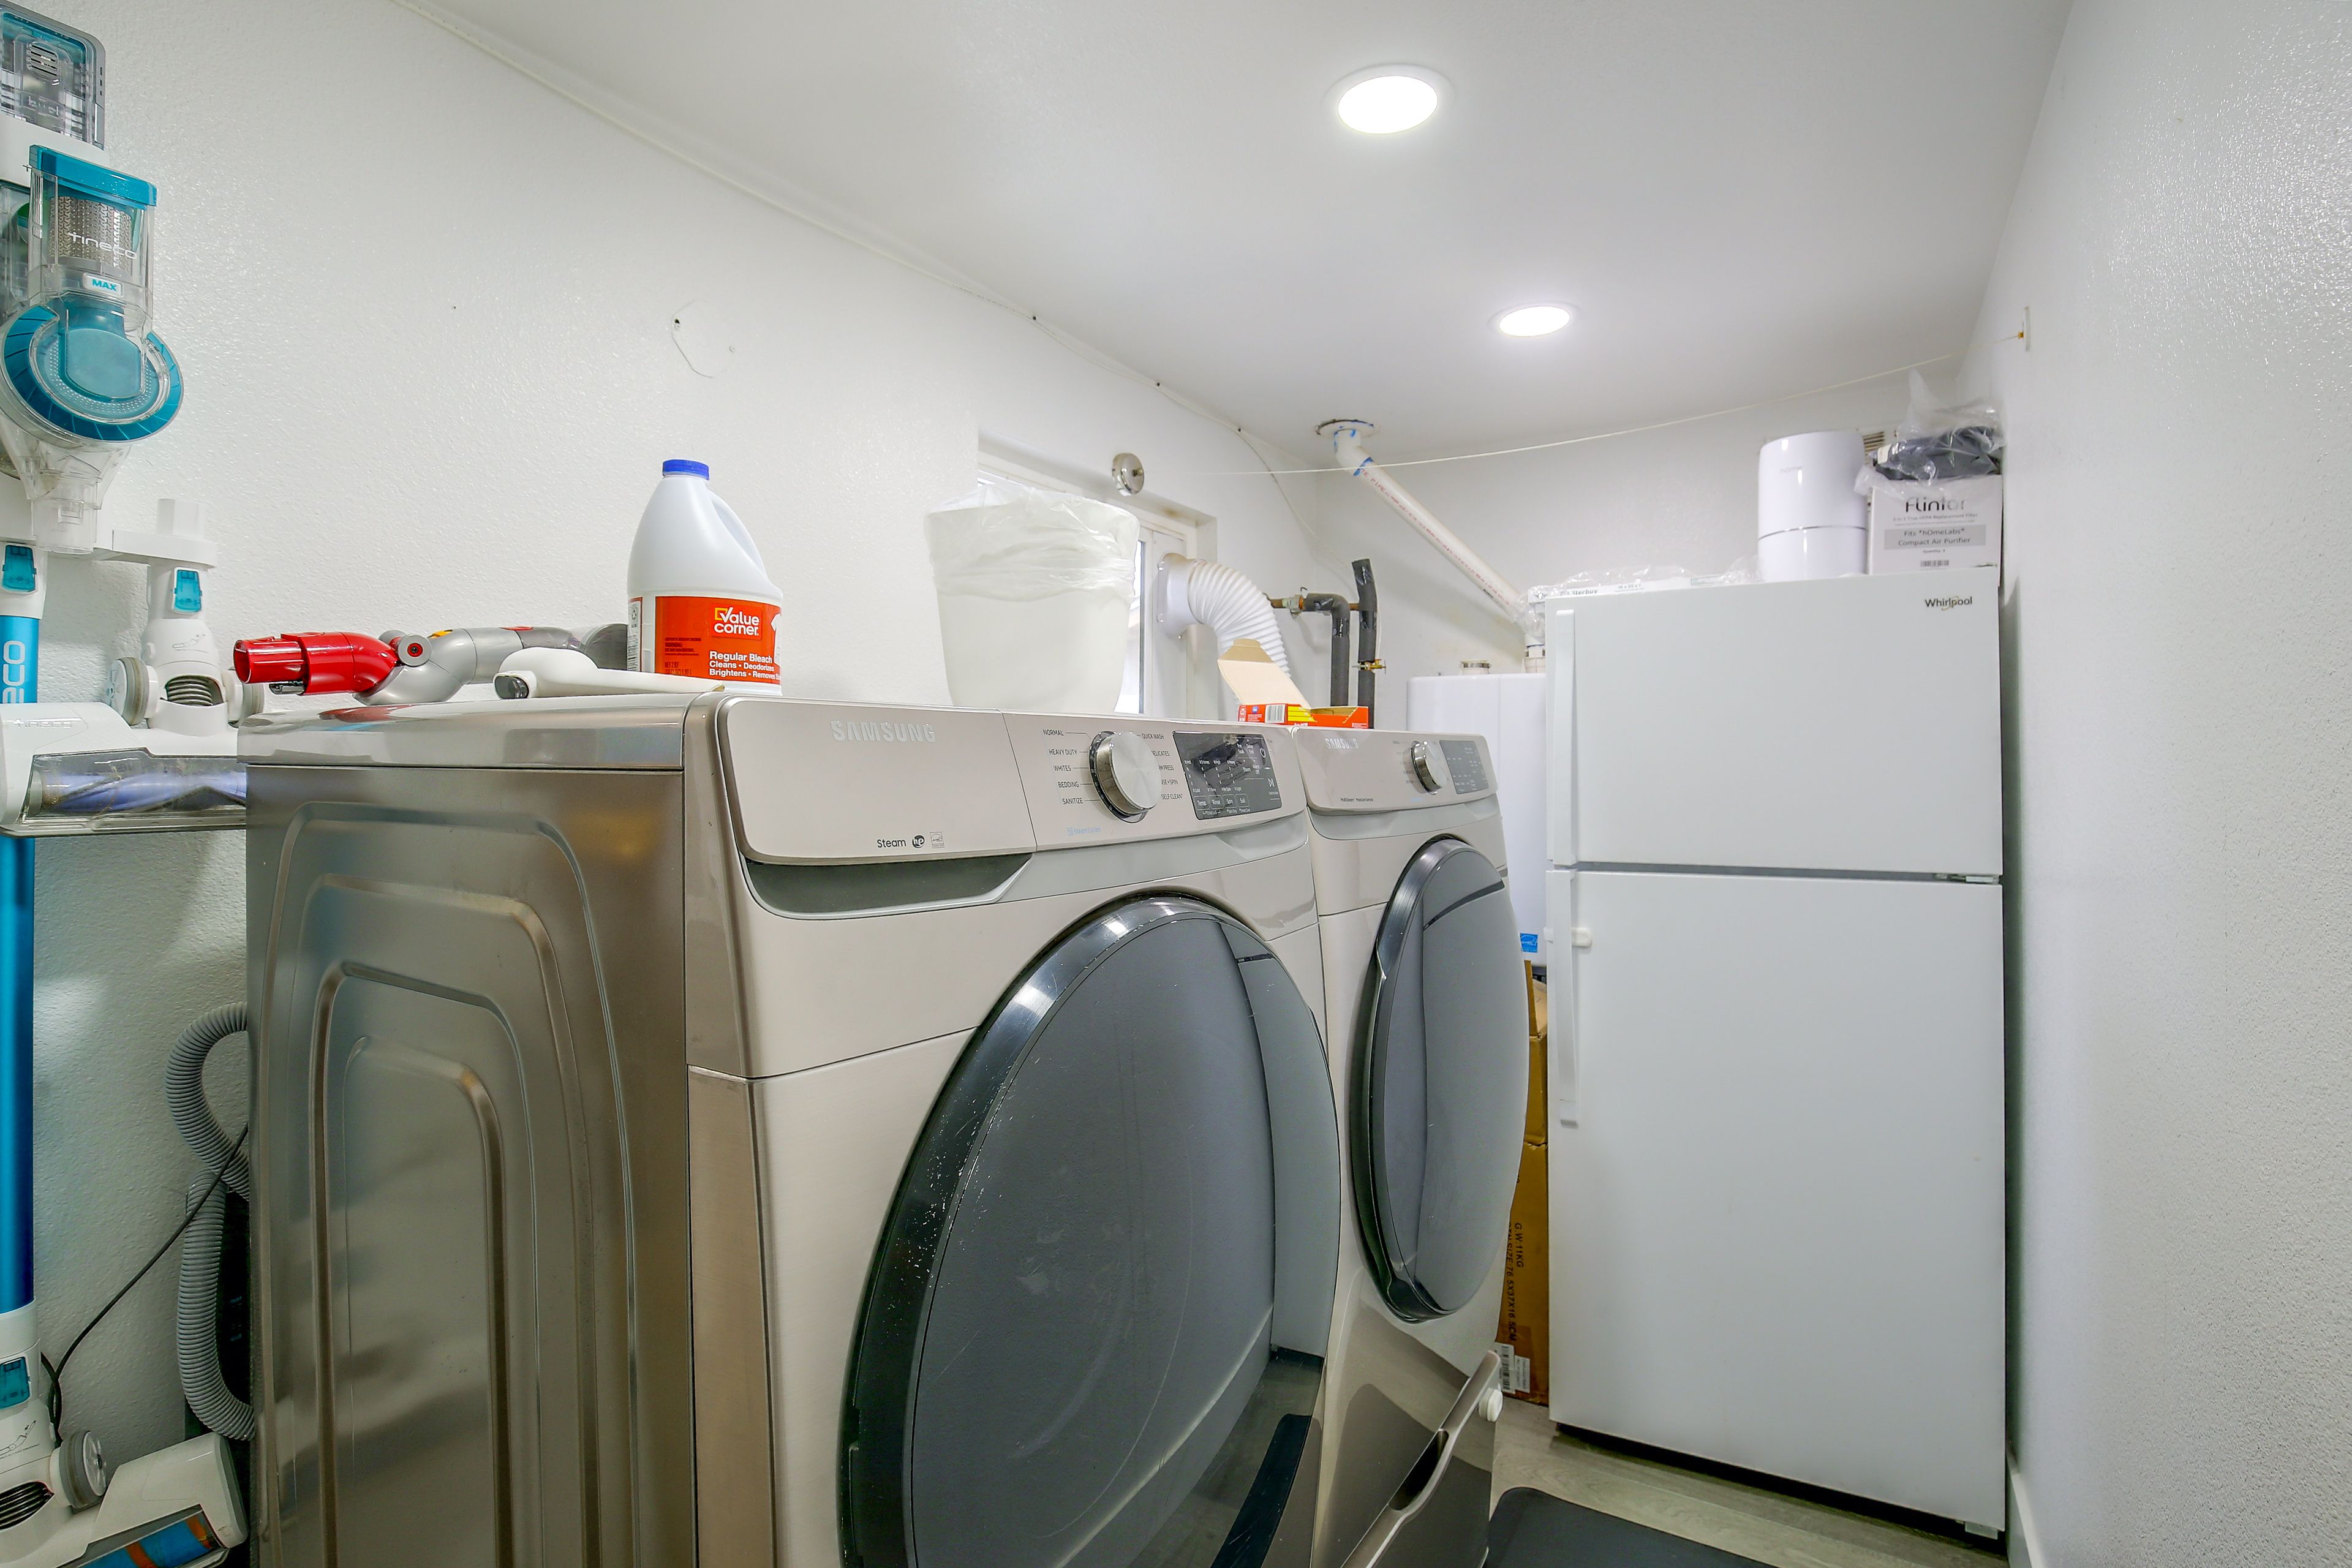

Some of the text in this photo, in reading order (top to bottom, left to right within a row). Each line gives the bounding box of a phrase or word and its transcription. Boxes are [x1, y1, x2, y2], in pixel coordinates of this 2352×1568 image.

[92, 279, 117, 292] MAX
[1924, 596, 1972, 608] Whirlpool
[720, 607, 760, 626] Value
[710, 651, 772, 663] Regular Bleach
[743, 662, 774, 671] Deodorizes
[709, 668, 747, 677] Brightens
[753, 671, 775, 679] Removes
[831, 720, 936, 743] SAMSUNG
[876, 839, 907, 848] Steam
